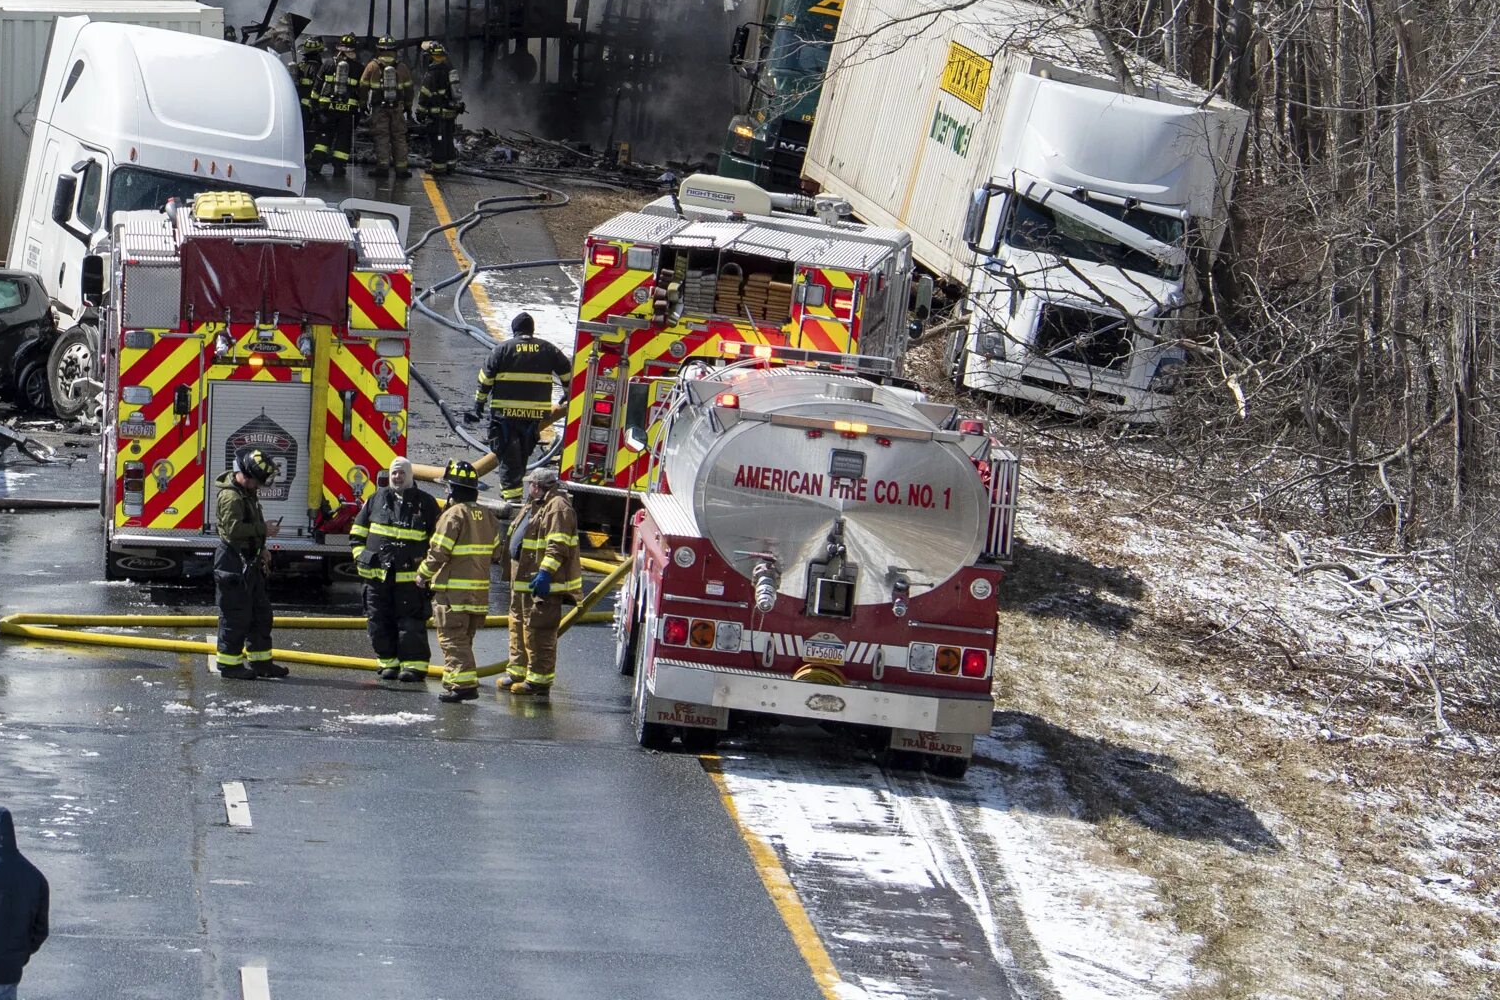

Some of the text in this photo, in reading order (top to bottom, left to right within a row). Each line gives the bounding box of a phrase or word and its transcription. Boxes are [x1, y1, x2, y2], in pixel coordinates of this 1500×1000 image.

[502, 408, 545, 419] FRACKVILLE
[244, 433, 279, 444] ENGINE
[733, 464, 824, 497] AMERICAN
[874, 479, 902, 505] CO.
[907, 483, 936, 509] NO.
[943, 488, 952, 510] 1
[657, 711, 718, 727] TRAIL BLAZER
[902, 738, 962, 754] TRAIL BLAZER
